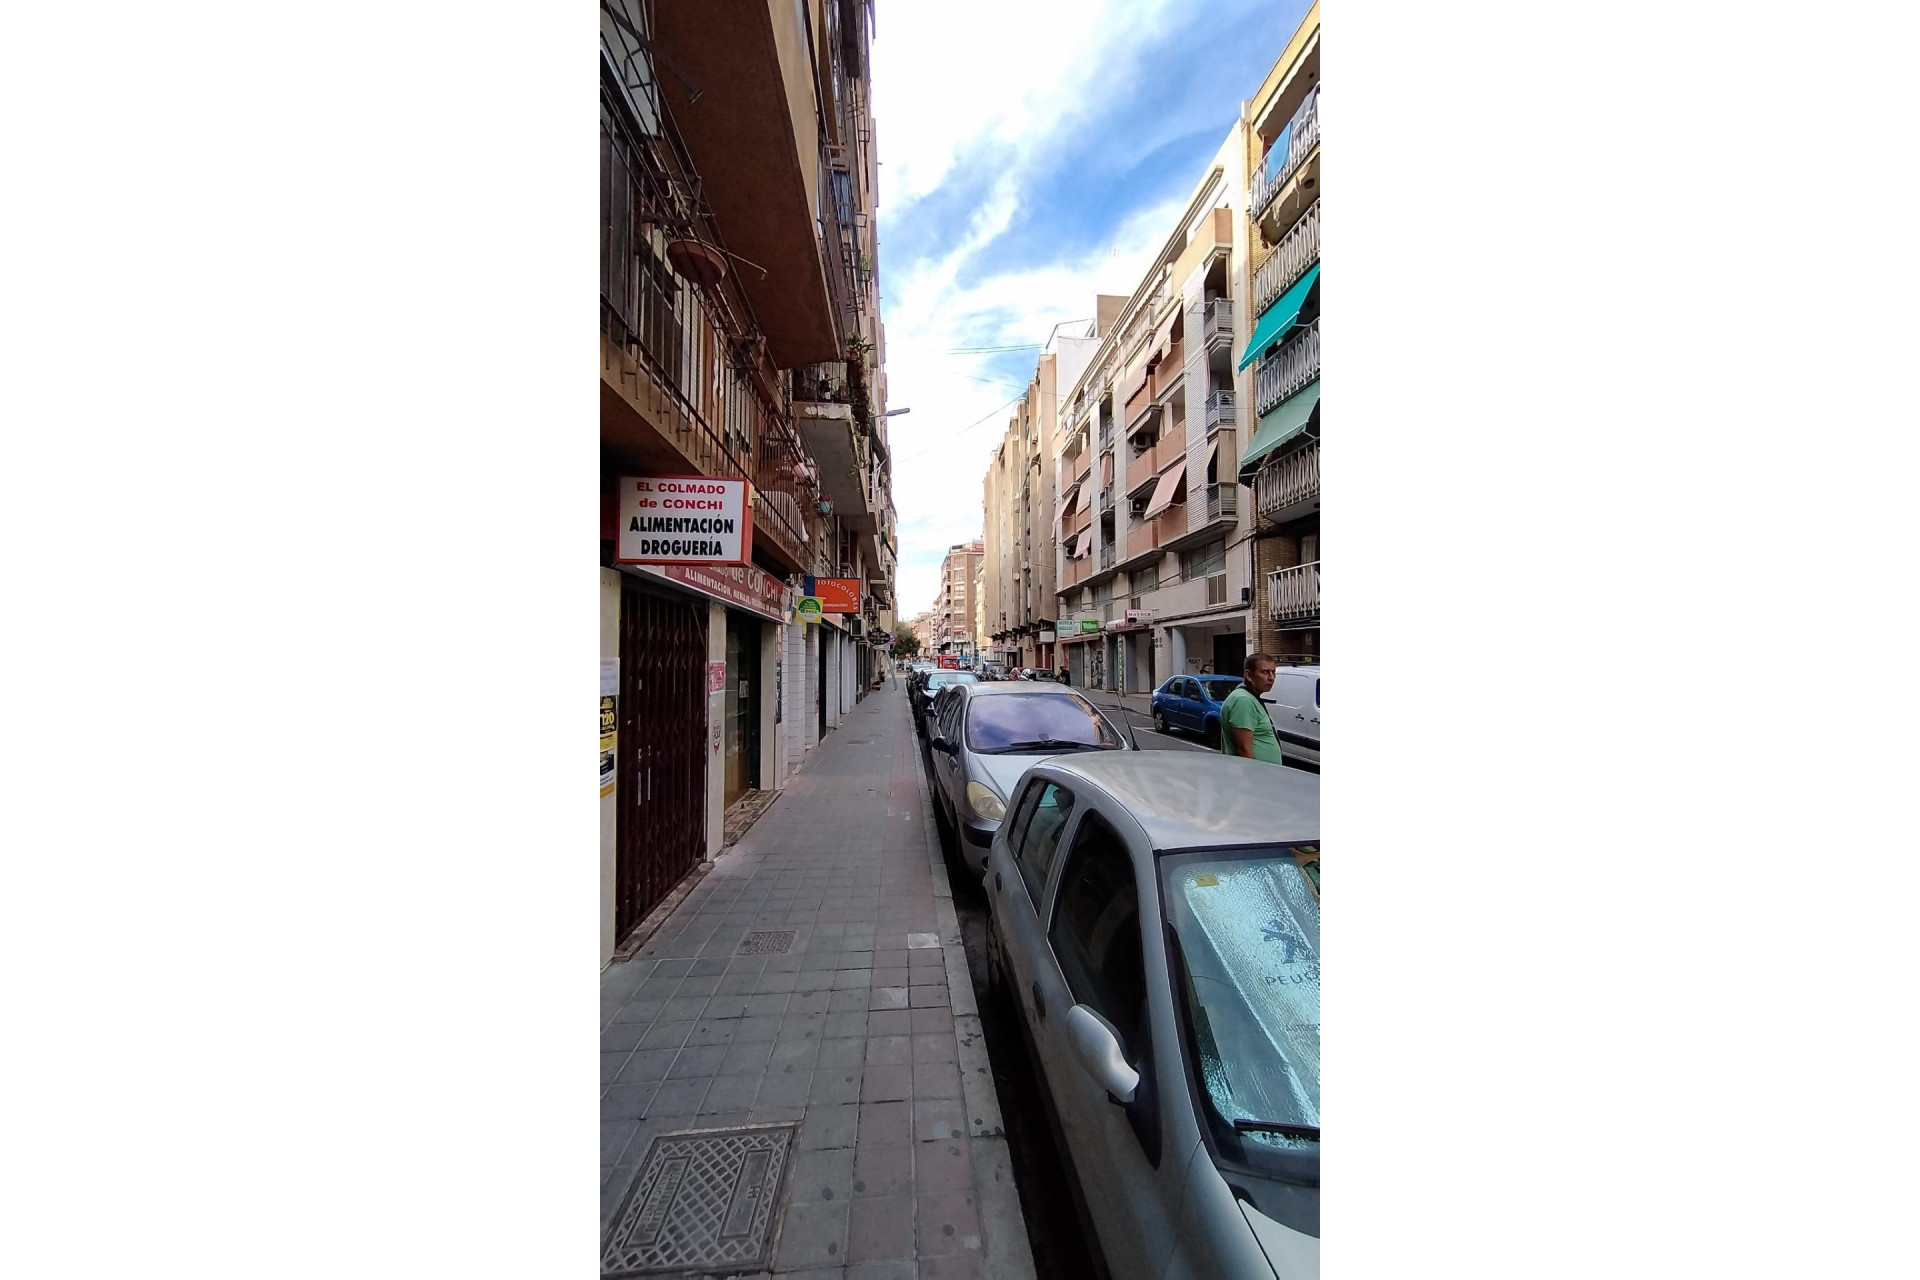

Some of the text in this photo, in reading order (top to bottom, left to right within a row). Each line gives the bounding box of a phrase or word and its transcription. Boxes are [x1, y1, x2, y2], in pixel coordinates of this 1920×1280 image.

[636, 481, 726, 495] EL COLMADO
[639, 498, 723, 510] de CONCHI
[629, 513, 734, 534] ALIMENTACIÓN
[640, 536, 723, 556] DROGUERÍA
[747, 568, 778, 603] CONCHI
